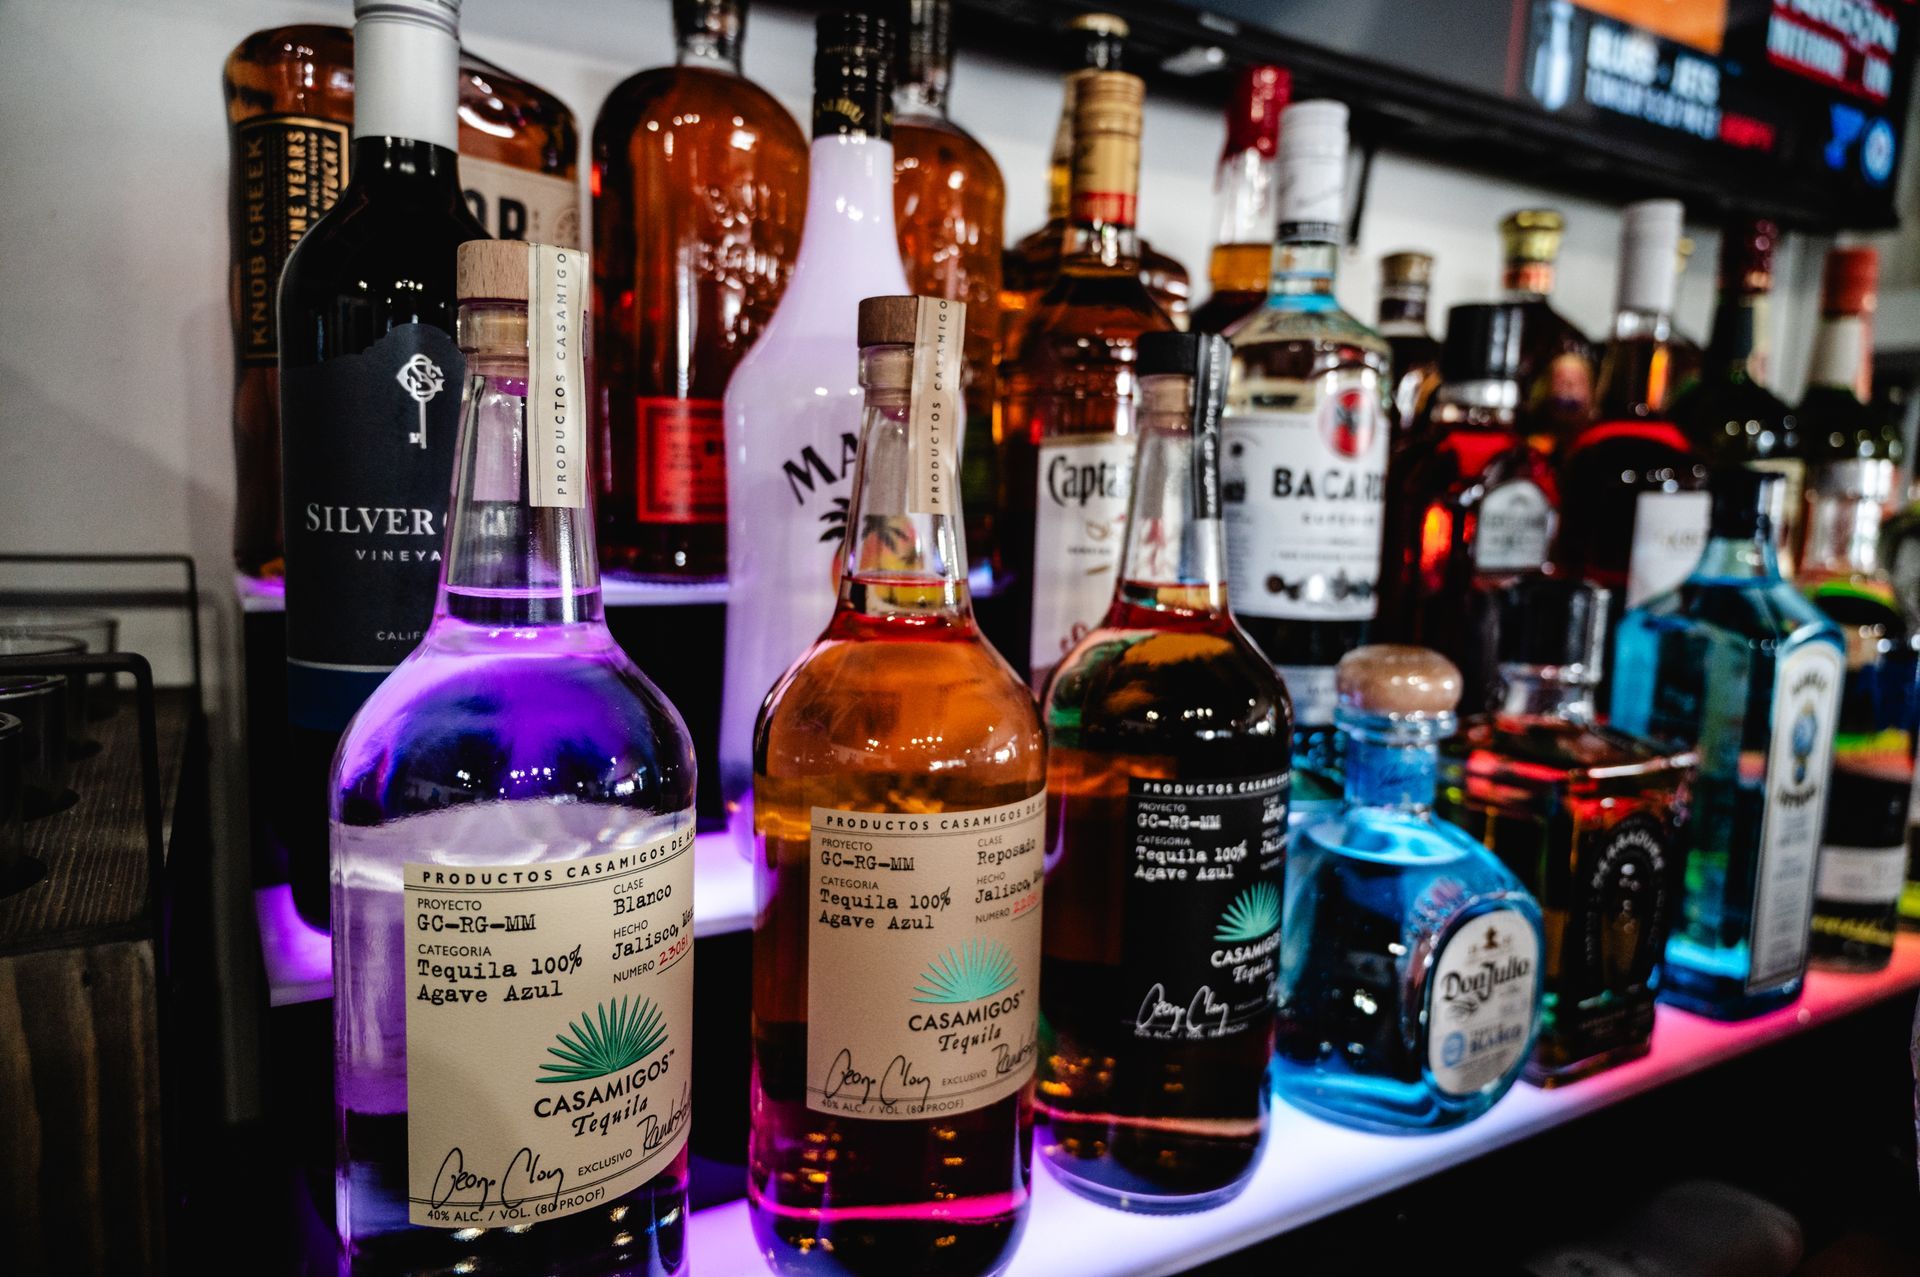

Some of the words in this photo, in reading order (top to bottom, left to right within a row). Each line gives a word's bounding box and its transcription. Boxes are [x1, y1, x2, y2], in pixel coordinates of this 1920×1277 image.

[288, 130, 307, 198] YEARS
[249, 136, 266, 246] CREEK
[252, 257, 268, 345] KNOB
[556, 246, 567, 361] CASAMIGO
[934, 300, 948, 391] CASAMIGO
[555, 375, 567, 495] PRODUCTOS
[931, 402, 941, 504] PRODUCTOS
[782, 432, 859, 506] MA
[1048, 455, 1132, 508] Capta
[305, 503, 437, 535] SILVER
[355, 549, 442, 562] VINEYA
[1143, 783, 1233, 795] PRODUCTOS
[826, 815, 929, 831] PRODUCTOS
[941, 808, 1022, 830] CASAMIGOS
[1138, 802, 1187, 813] PROYECTO
[1137, 812, 1222, 830] GC-RG-MM
[822, 838, 873, 851] PROYECTO
[977, 835, 1002, 847] CLASE
[977, 838, 1036, 866] Reposado
[1135, 845, 1208, 865] Tequila
[1214, 839, 1248, 862] 100%
[1136, 835, 1191, 846] CATEGORIA
[422, 869, 553, 885] PRODUCTOS
[566, 845, 665, 878] CASAMIGOS
[671, 836, 682, 851] DE
[821, 851, 916, 871] GC-RG-MM
[1134, 864, 1188, 882] Agave
[1196, 864, 1235, 881] Azul
[613, 878, 644, 895] CLASE
[821, 876, 879, 890] CATEGORIA
[976, 871, 1006, 885] HECHO
[417, 898, 482, 911] PROYECTO
[613, 884, 672, 916] Blanco
[820, 888, 899, 910] Tequila
[909, 886, 951, 912] 100%
[417, 913, 537, 933] GC-RG-MM
[819, 910, 875, 928] Agave
[887, 914, 935, 930] Azul
[975, 907, 1010, 923] NUMERO
[612, 924, 679, 960] Jalisco,
[613, 919, 648, 939] HECHO
[417, 959, 517, 982] Tequila
[531, 944, 583, 975] 100%
[418, 944, 491, 957] CATEGORIA
[613, 960, 655, 983] NUMERO
[417, 984, 487, 1006] Agave
[503, 980, 563, 1003] Azul
[1442, 971, 1484, 1001] Don
[908, 993, 1020, 1032] CASAMIGOS
[938, 1023, 1001, 1054] Tequila
[534, 1054, 670, 1118] CASAMIGOS
[941, 1069, 988, 1086] EXCLUSIVO
[571, 1093, 648, 1137] Tequila
[842, 1102, 866, 1113] ALC.
[578, 1149, 632, 1176] EXCLUSIVO
[427, 1209, 450, 1221] 40%
[453, 1210, 483, 1222] ALC.
[500, 1206, 531, 1220] VOL.
[560, 1186, 605, 1212] PROOF)
